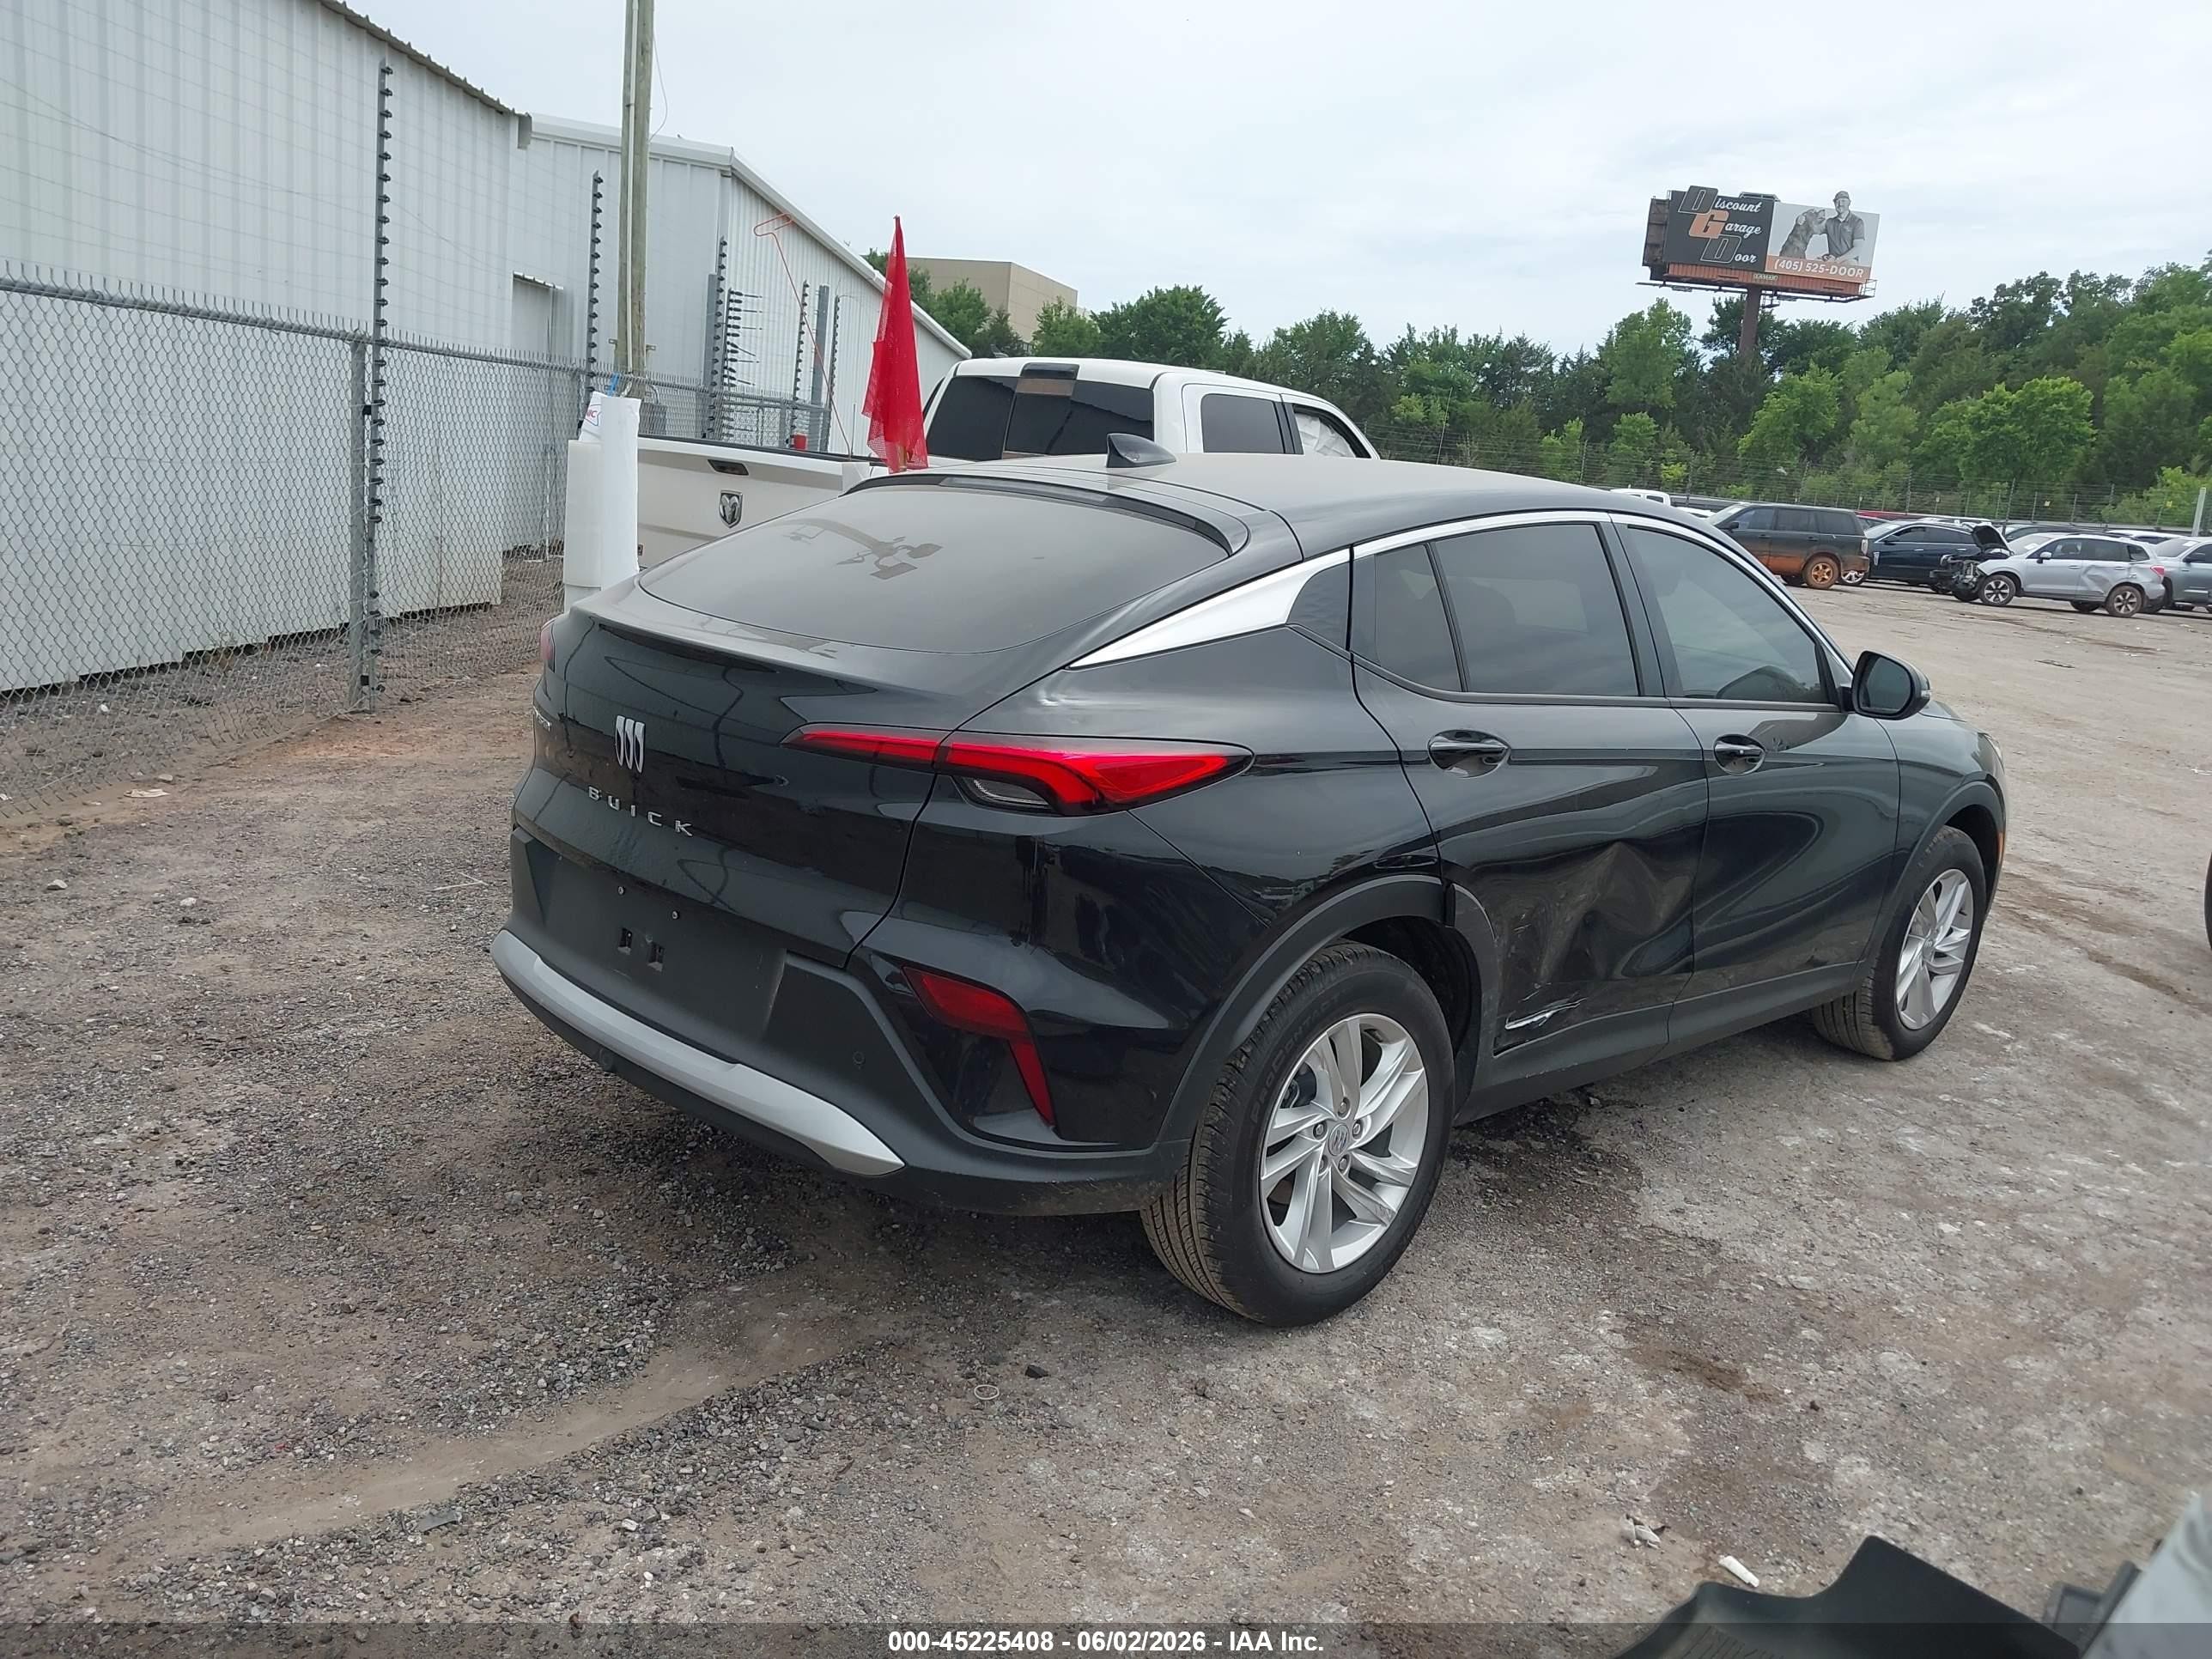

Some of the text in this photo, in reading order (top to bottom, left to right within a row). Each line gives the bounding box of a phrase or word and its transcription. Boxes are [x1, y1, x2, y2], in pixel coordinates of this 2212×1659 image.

[1678, 185, 1760, 215] Discount
[1688, 210, 1763, 240] Garage
[1700, 234, 1758, 264] Door
[1774, 258, 1864, 279] (405) 525-DOOR
[588, 785, 692, 836] BUICK
